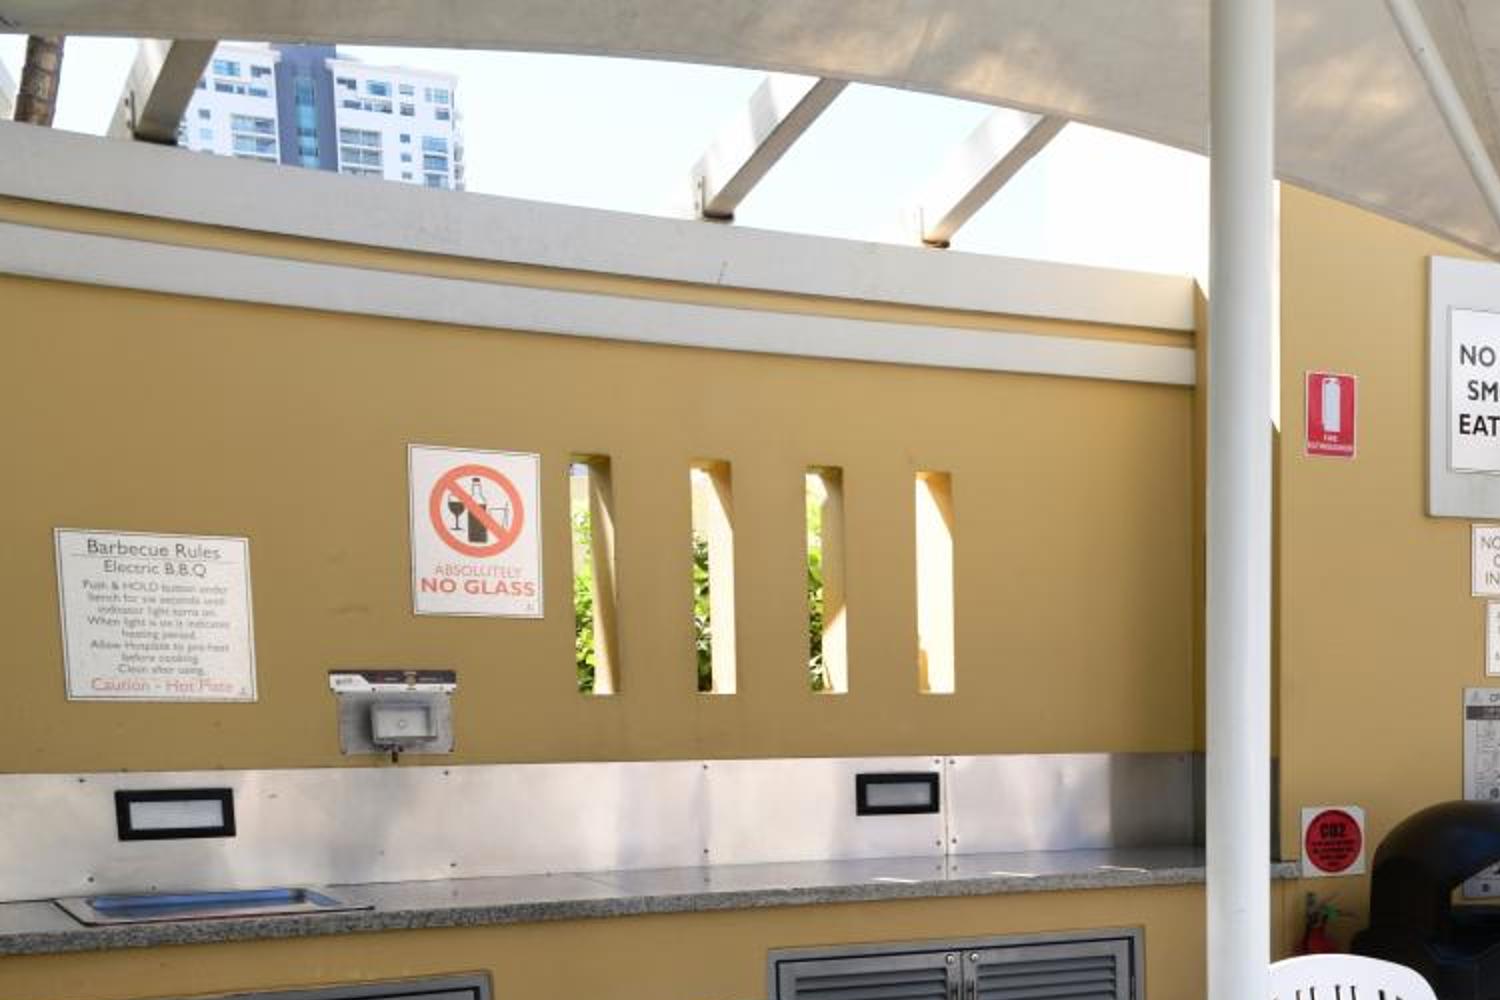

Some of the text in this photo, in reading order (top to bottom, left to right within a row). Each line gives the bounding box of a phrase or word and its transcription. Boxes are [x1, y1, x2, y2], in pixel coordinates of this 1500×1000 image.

[1459, 343, 1496, 367] NO
[87, 539, 222, 560] Barbecue Rules
[103, 560, 159, 575] Electric
[435, 563, 523, 578] ABSOLUTELY
[1485, 571, 1500, 585] IN
[123, 581, 159, 592] HOLD
[421, 577, 537, 597] NO GLASS
[92, 677, 150, 691] Caution
[166, 679, 194, 692] Hot
[199, 679, 235, 692] Plate
